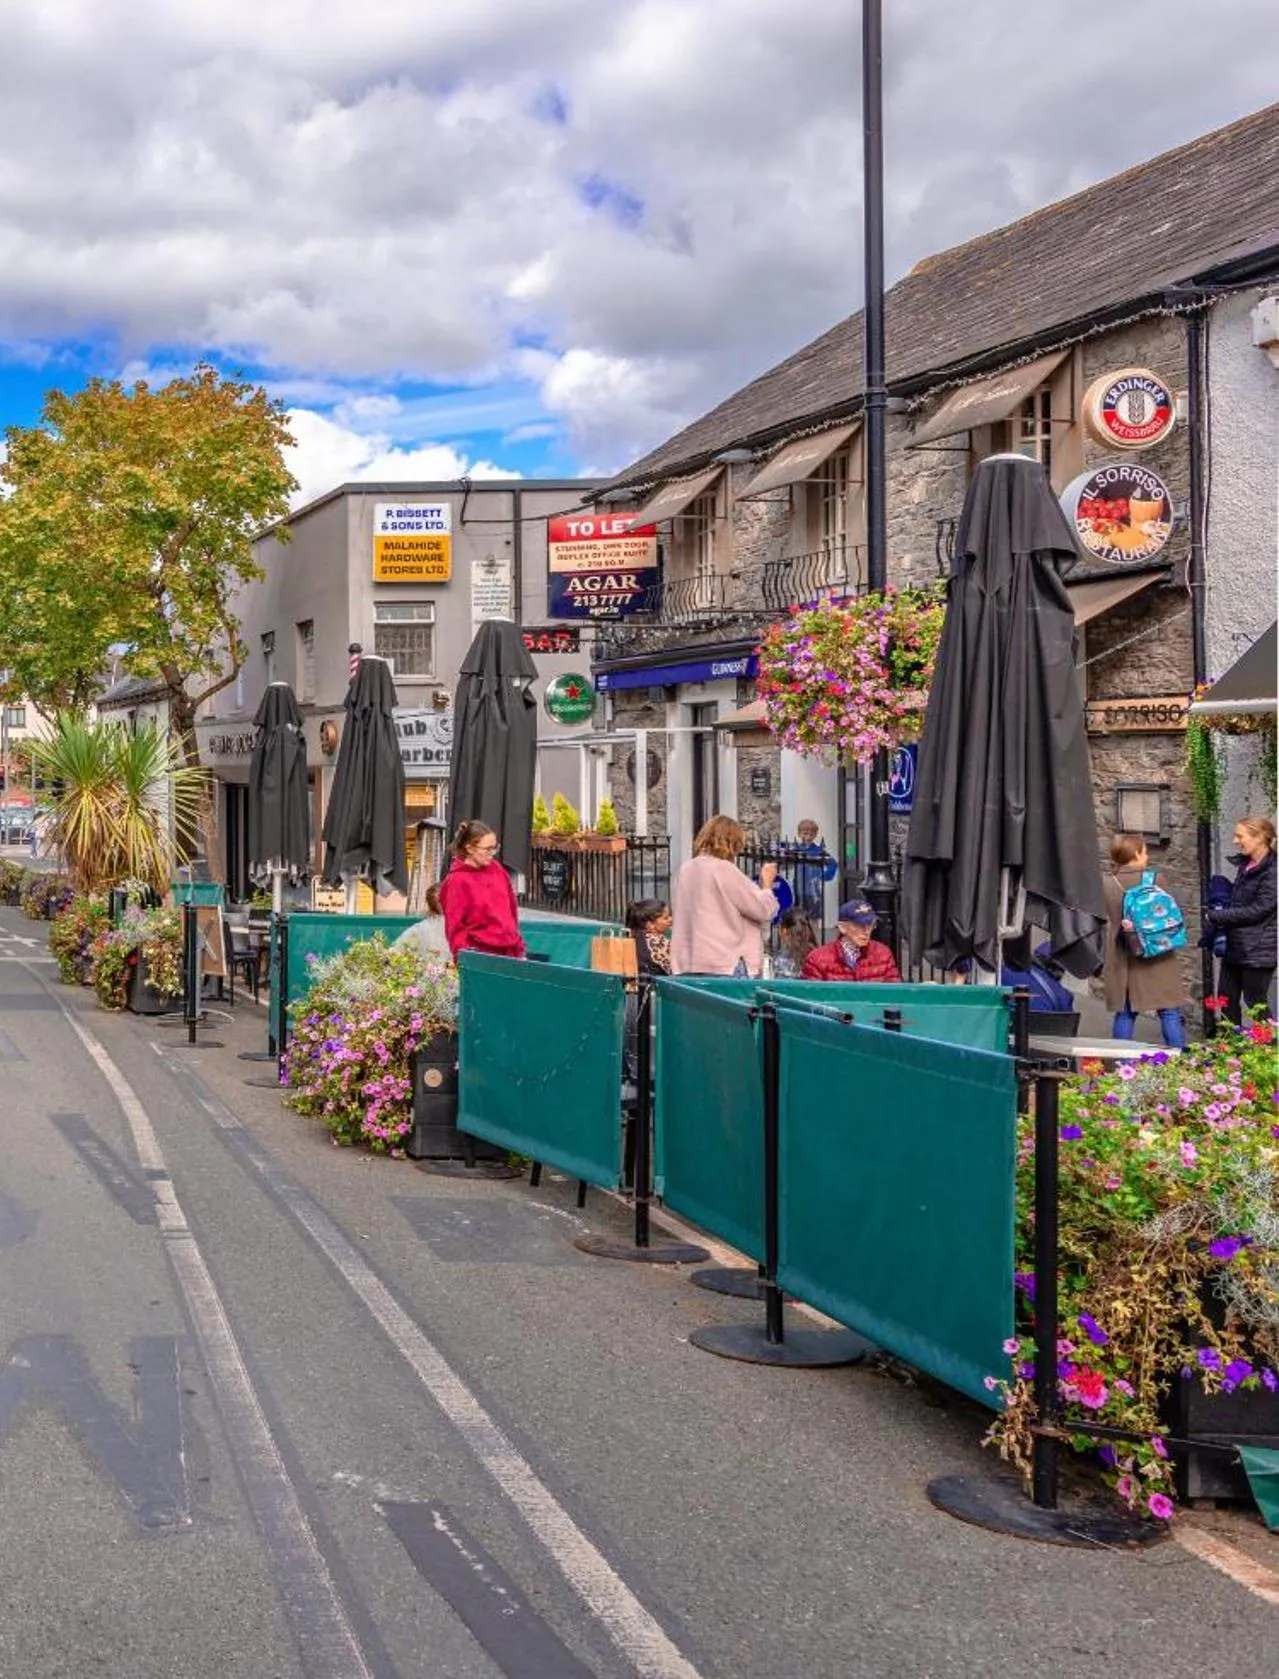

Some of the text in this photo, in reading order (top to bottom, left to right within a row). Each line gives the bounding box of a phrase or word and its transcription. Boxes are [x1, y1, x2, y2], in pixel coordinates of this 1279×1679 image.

[1105, 378, 1165, 405] ERDINGER
[1082, 466, 1165, 501] IL SORRISO
[396, 508, 442, 518] BISSETT
[381, 521, 447, 530] & SONS LTD.
[567, 521, 594, 537] TO
[384, 541, 442, 551] MALAHIDE
[381, 553, 445, 562] HARDWARE
[381, 565, 448, 574] STORES LTD.
[567, 574, 640, 592] AGAR
